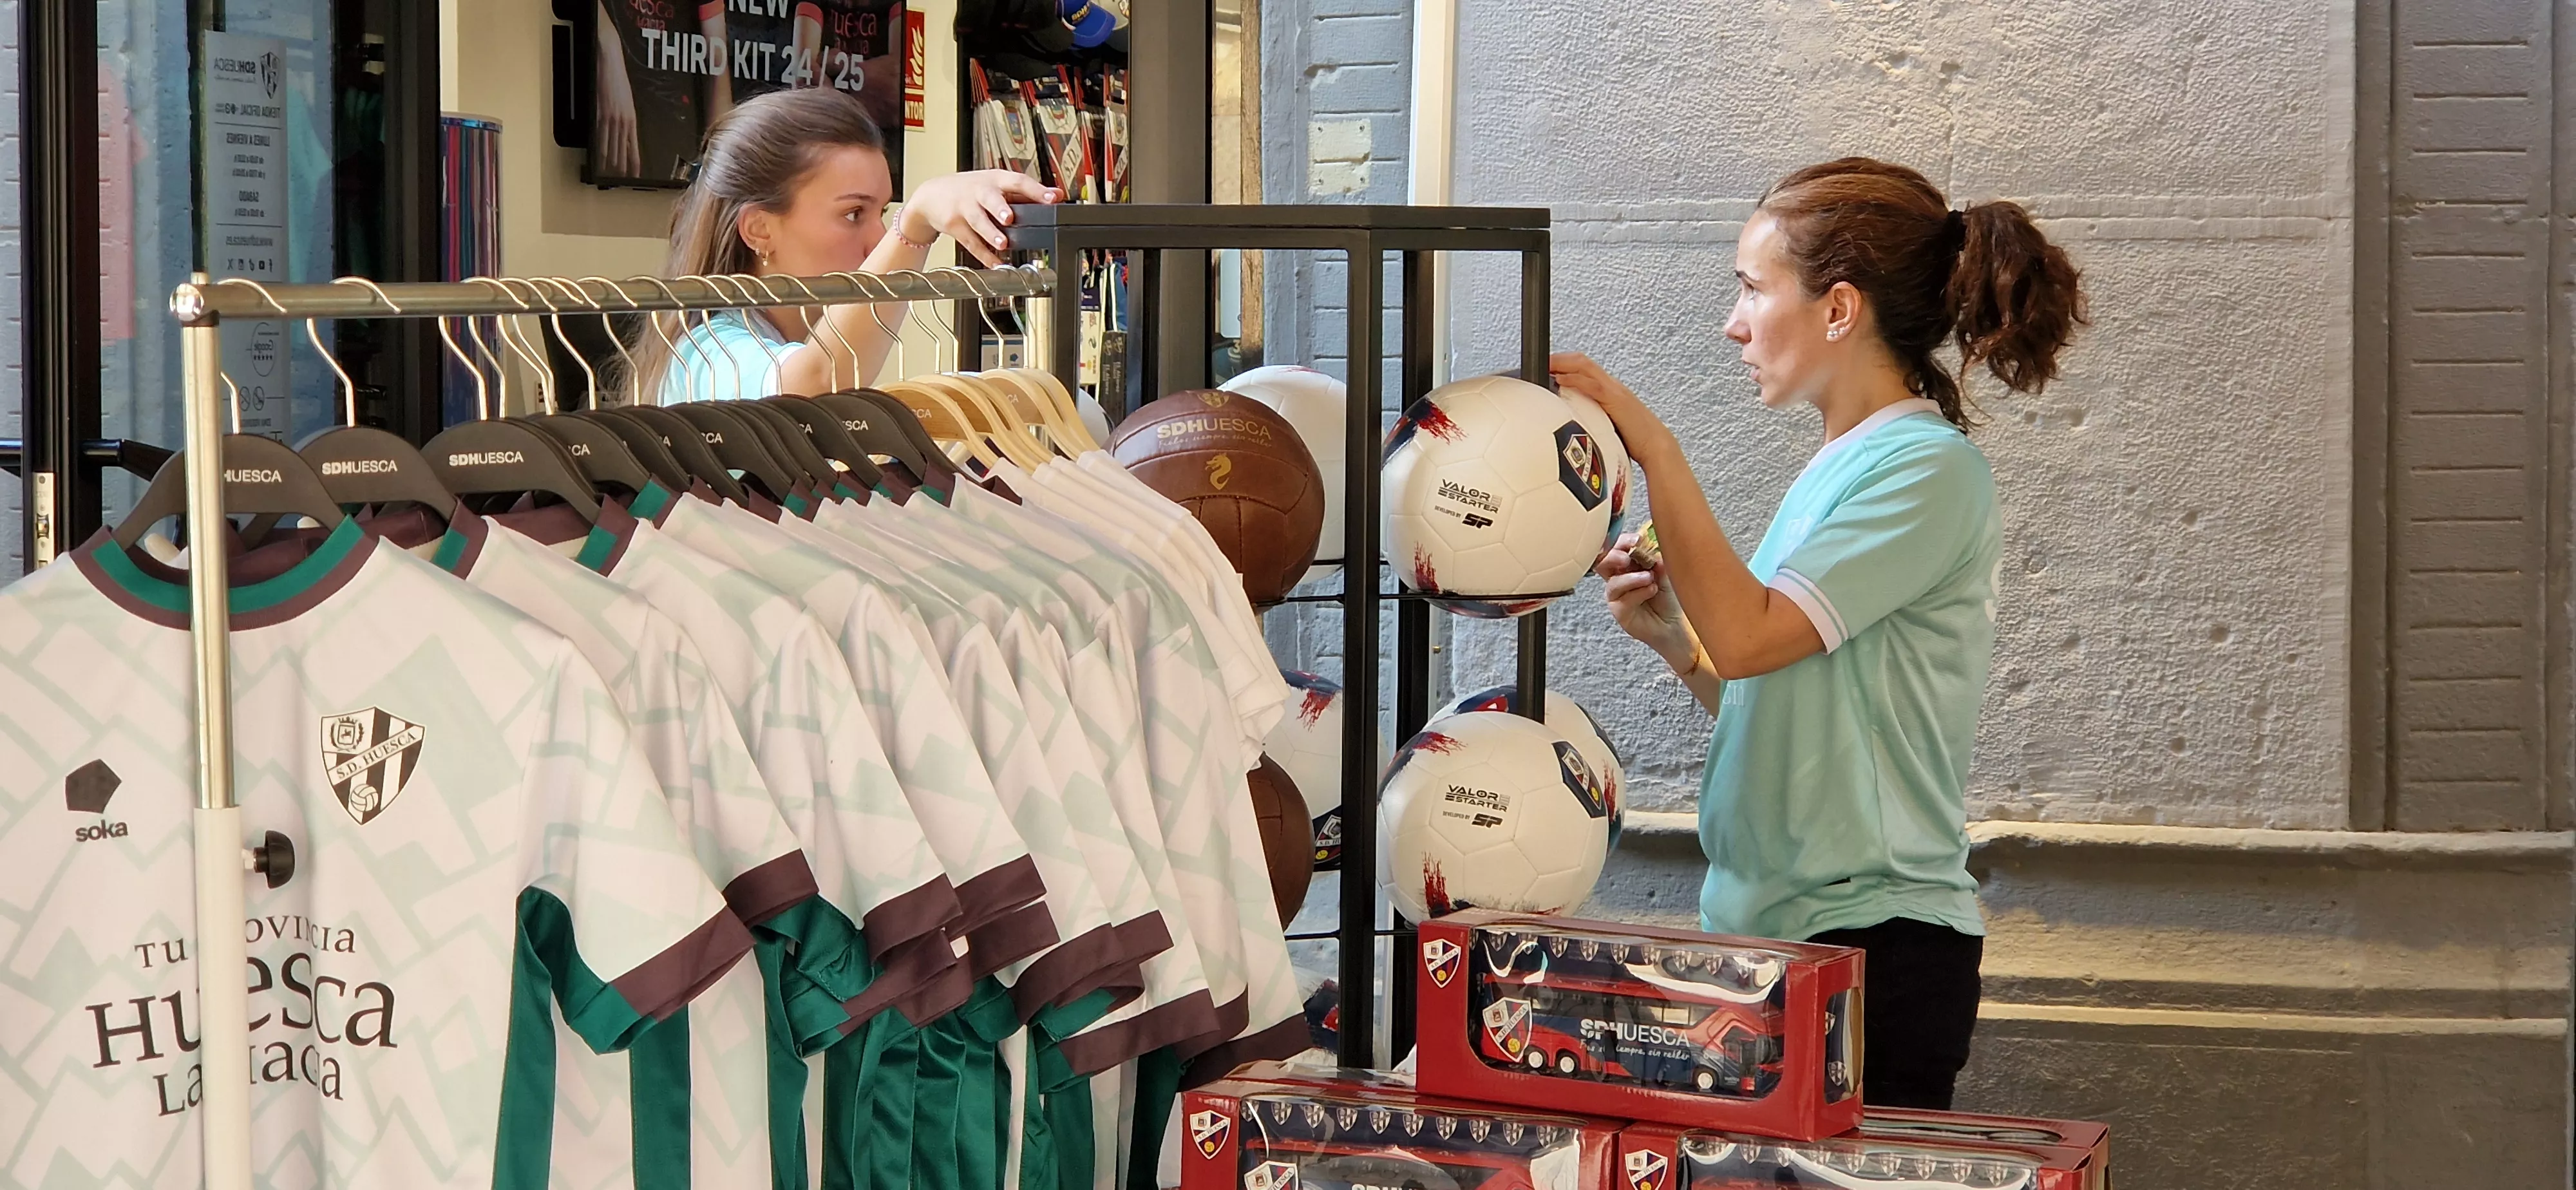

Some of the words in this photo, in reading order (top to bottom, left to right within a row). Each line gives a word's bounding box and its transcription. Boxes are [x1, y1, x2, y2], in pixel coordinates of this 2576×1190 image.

[641, 28, 728, 76] THIRD
[734, 39, 776, 81] KIT
[781, 45, 813, 86] 24
[835, 52, 864, 91] 25
[1157, 418, 1271, 440] SDHUESCA
[449, 451, 524, 466] SDHUESCA
[224, 469, 282, 482] HUESCA
[322, 460, 397, 475] SDHUESCA
[1442, 478, 1491, 502] VALOR
[1462, 513, 1493, 529] SP
[336, 761, 361, 779] S.D.
[363, 732, 416, 765] HUESCA
[1448, 784, 1499, 801] VALOR
[1472, 813, 1503, 828] SP
[75, 819, 128, 842] soka
